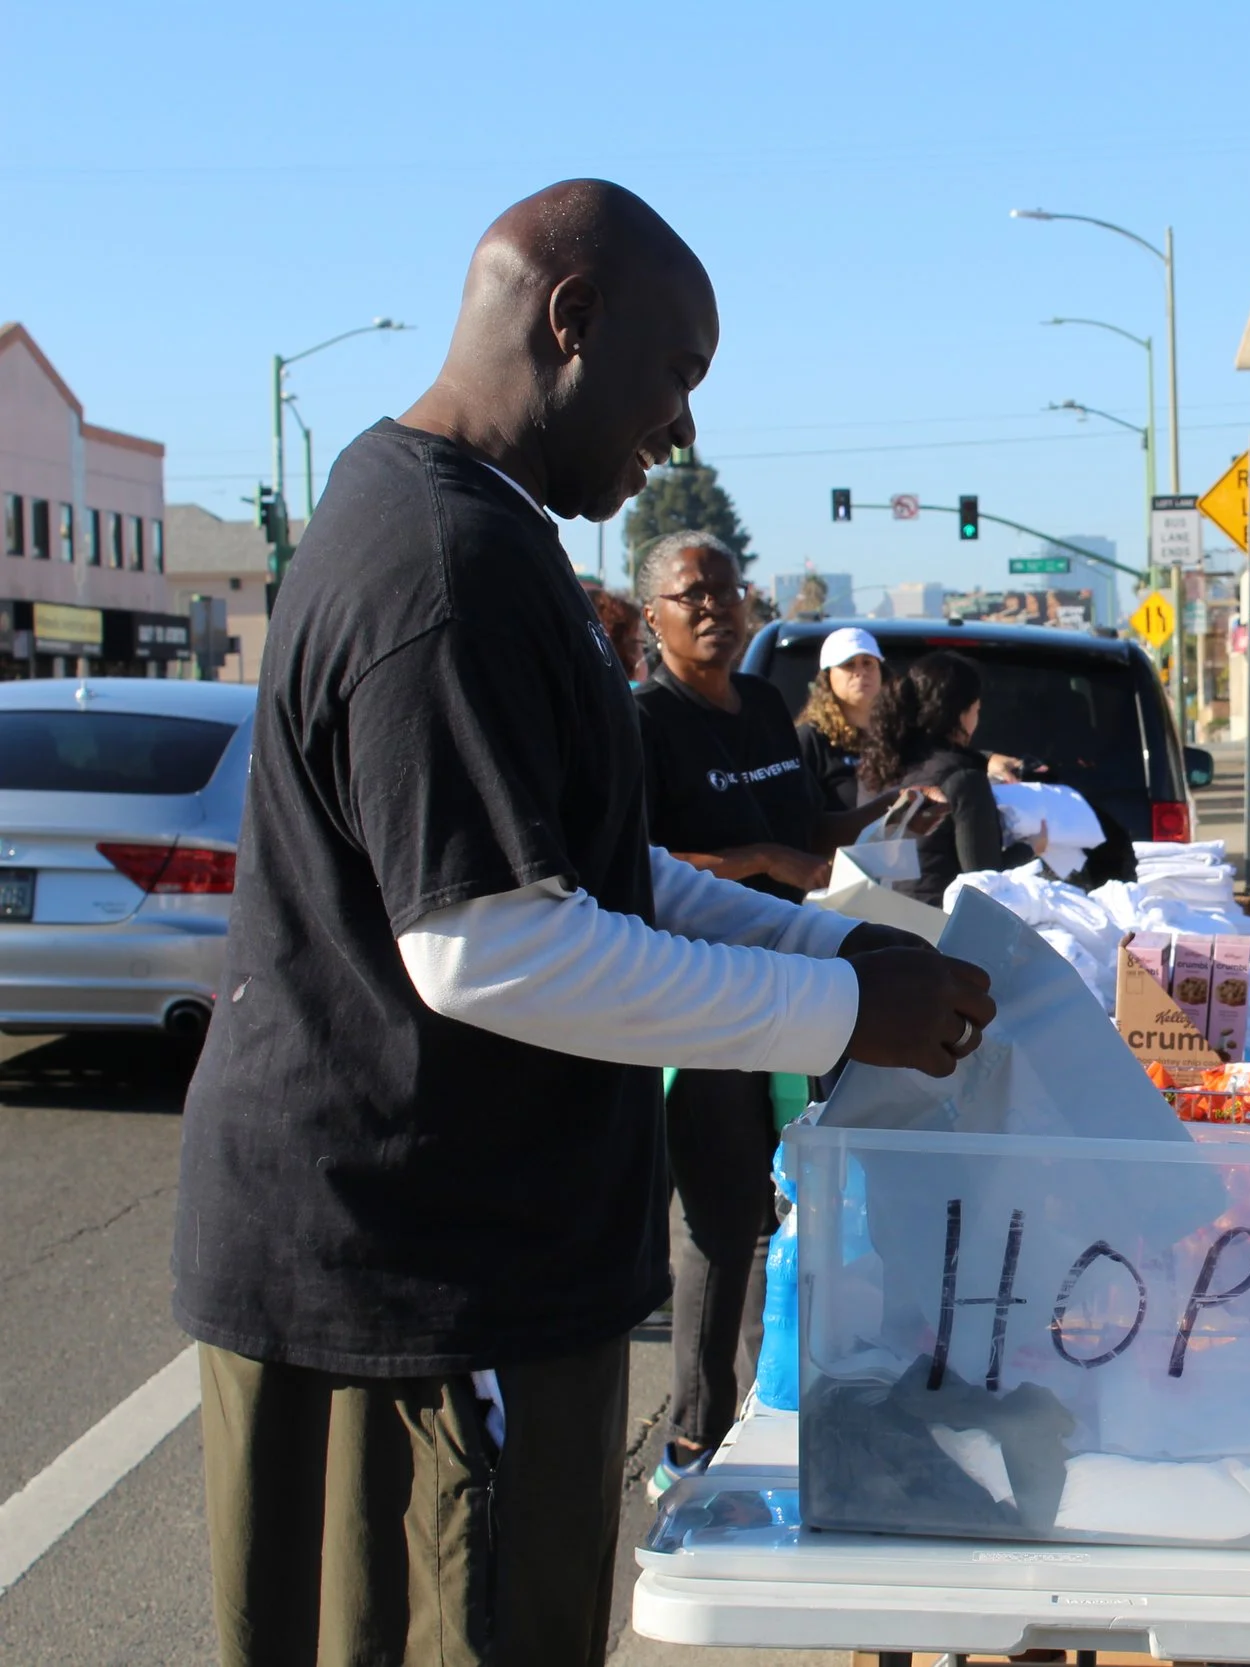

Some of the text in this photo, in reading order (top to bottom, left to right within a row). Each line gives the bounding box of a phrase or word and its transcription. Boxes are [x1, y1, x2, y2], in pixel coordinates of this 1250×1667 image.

[1163, 517, 1187, 529] BUS
[1160, 532, 1191, 544] LANE
[1161, 547, 1191, 559] ENDS
[748, 763, 782, 782] NEVER
[781, 757, 801, 773] FAIL
[1127, 1030, 1211, 1052] crum
